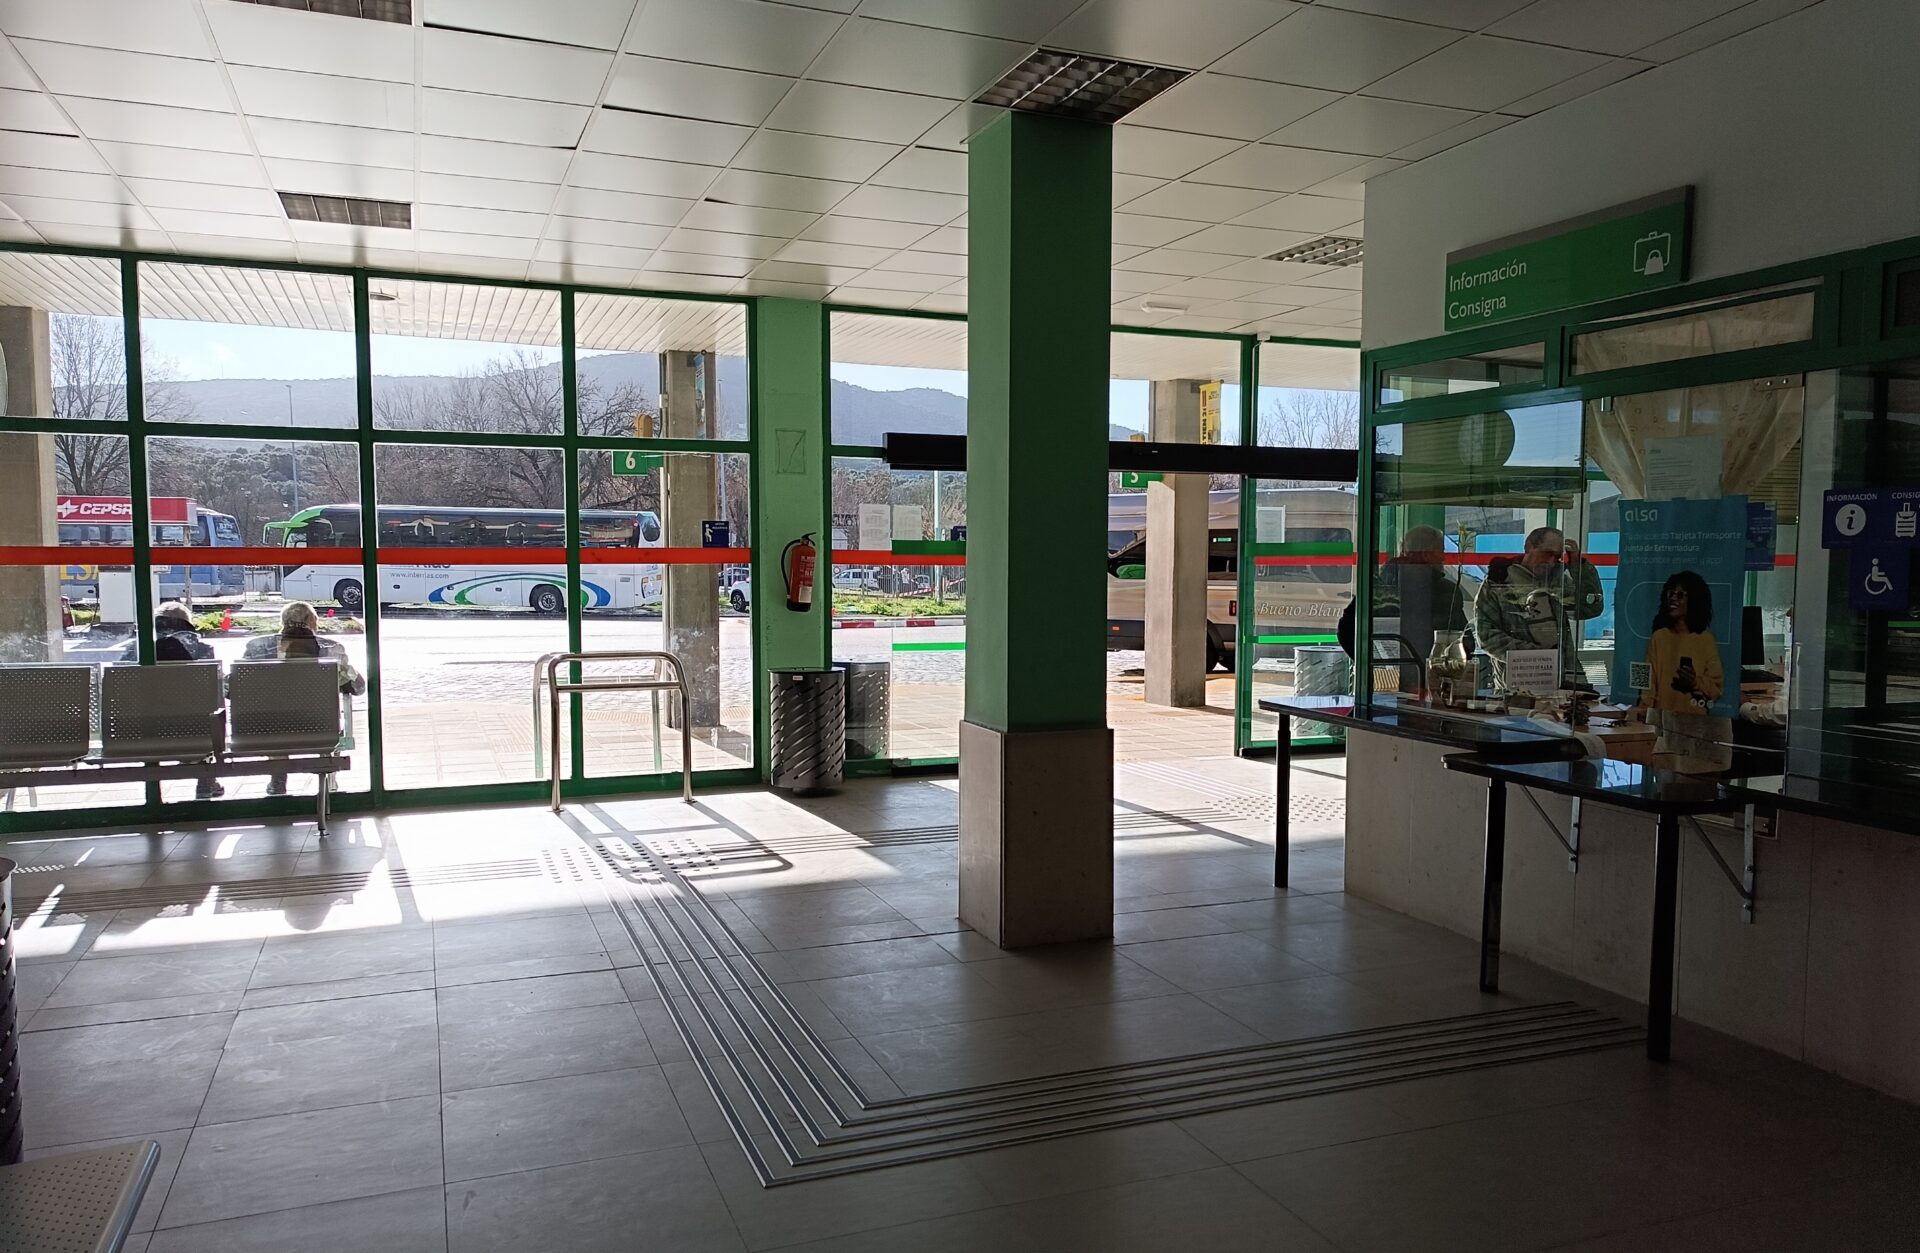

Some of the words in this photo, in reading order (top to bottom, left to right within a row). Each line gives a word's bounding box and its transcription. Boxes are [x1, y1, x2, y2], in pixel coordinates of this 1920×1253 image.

[1450, 258, 1527, 292] Información
[1448, 296, 1506, 319] Consigna
[625, 451, 636, 470] 6
[1826, 493, 1878, 502] INFORMACIÓN
[79, 502, 132, 515] CEPSA
[1625, 507, 1658, 522] alsa
[1258, 601, 1302, 616] Bueno
[1306, 602, 1343, 617] Blan
